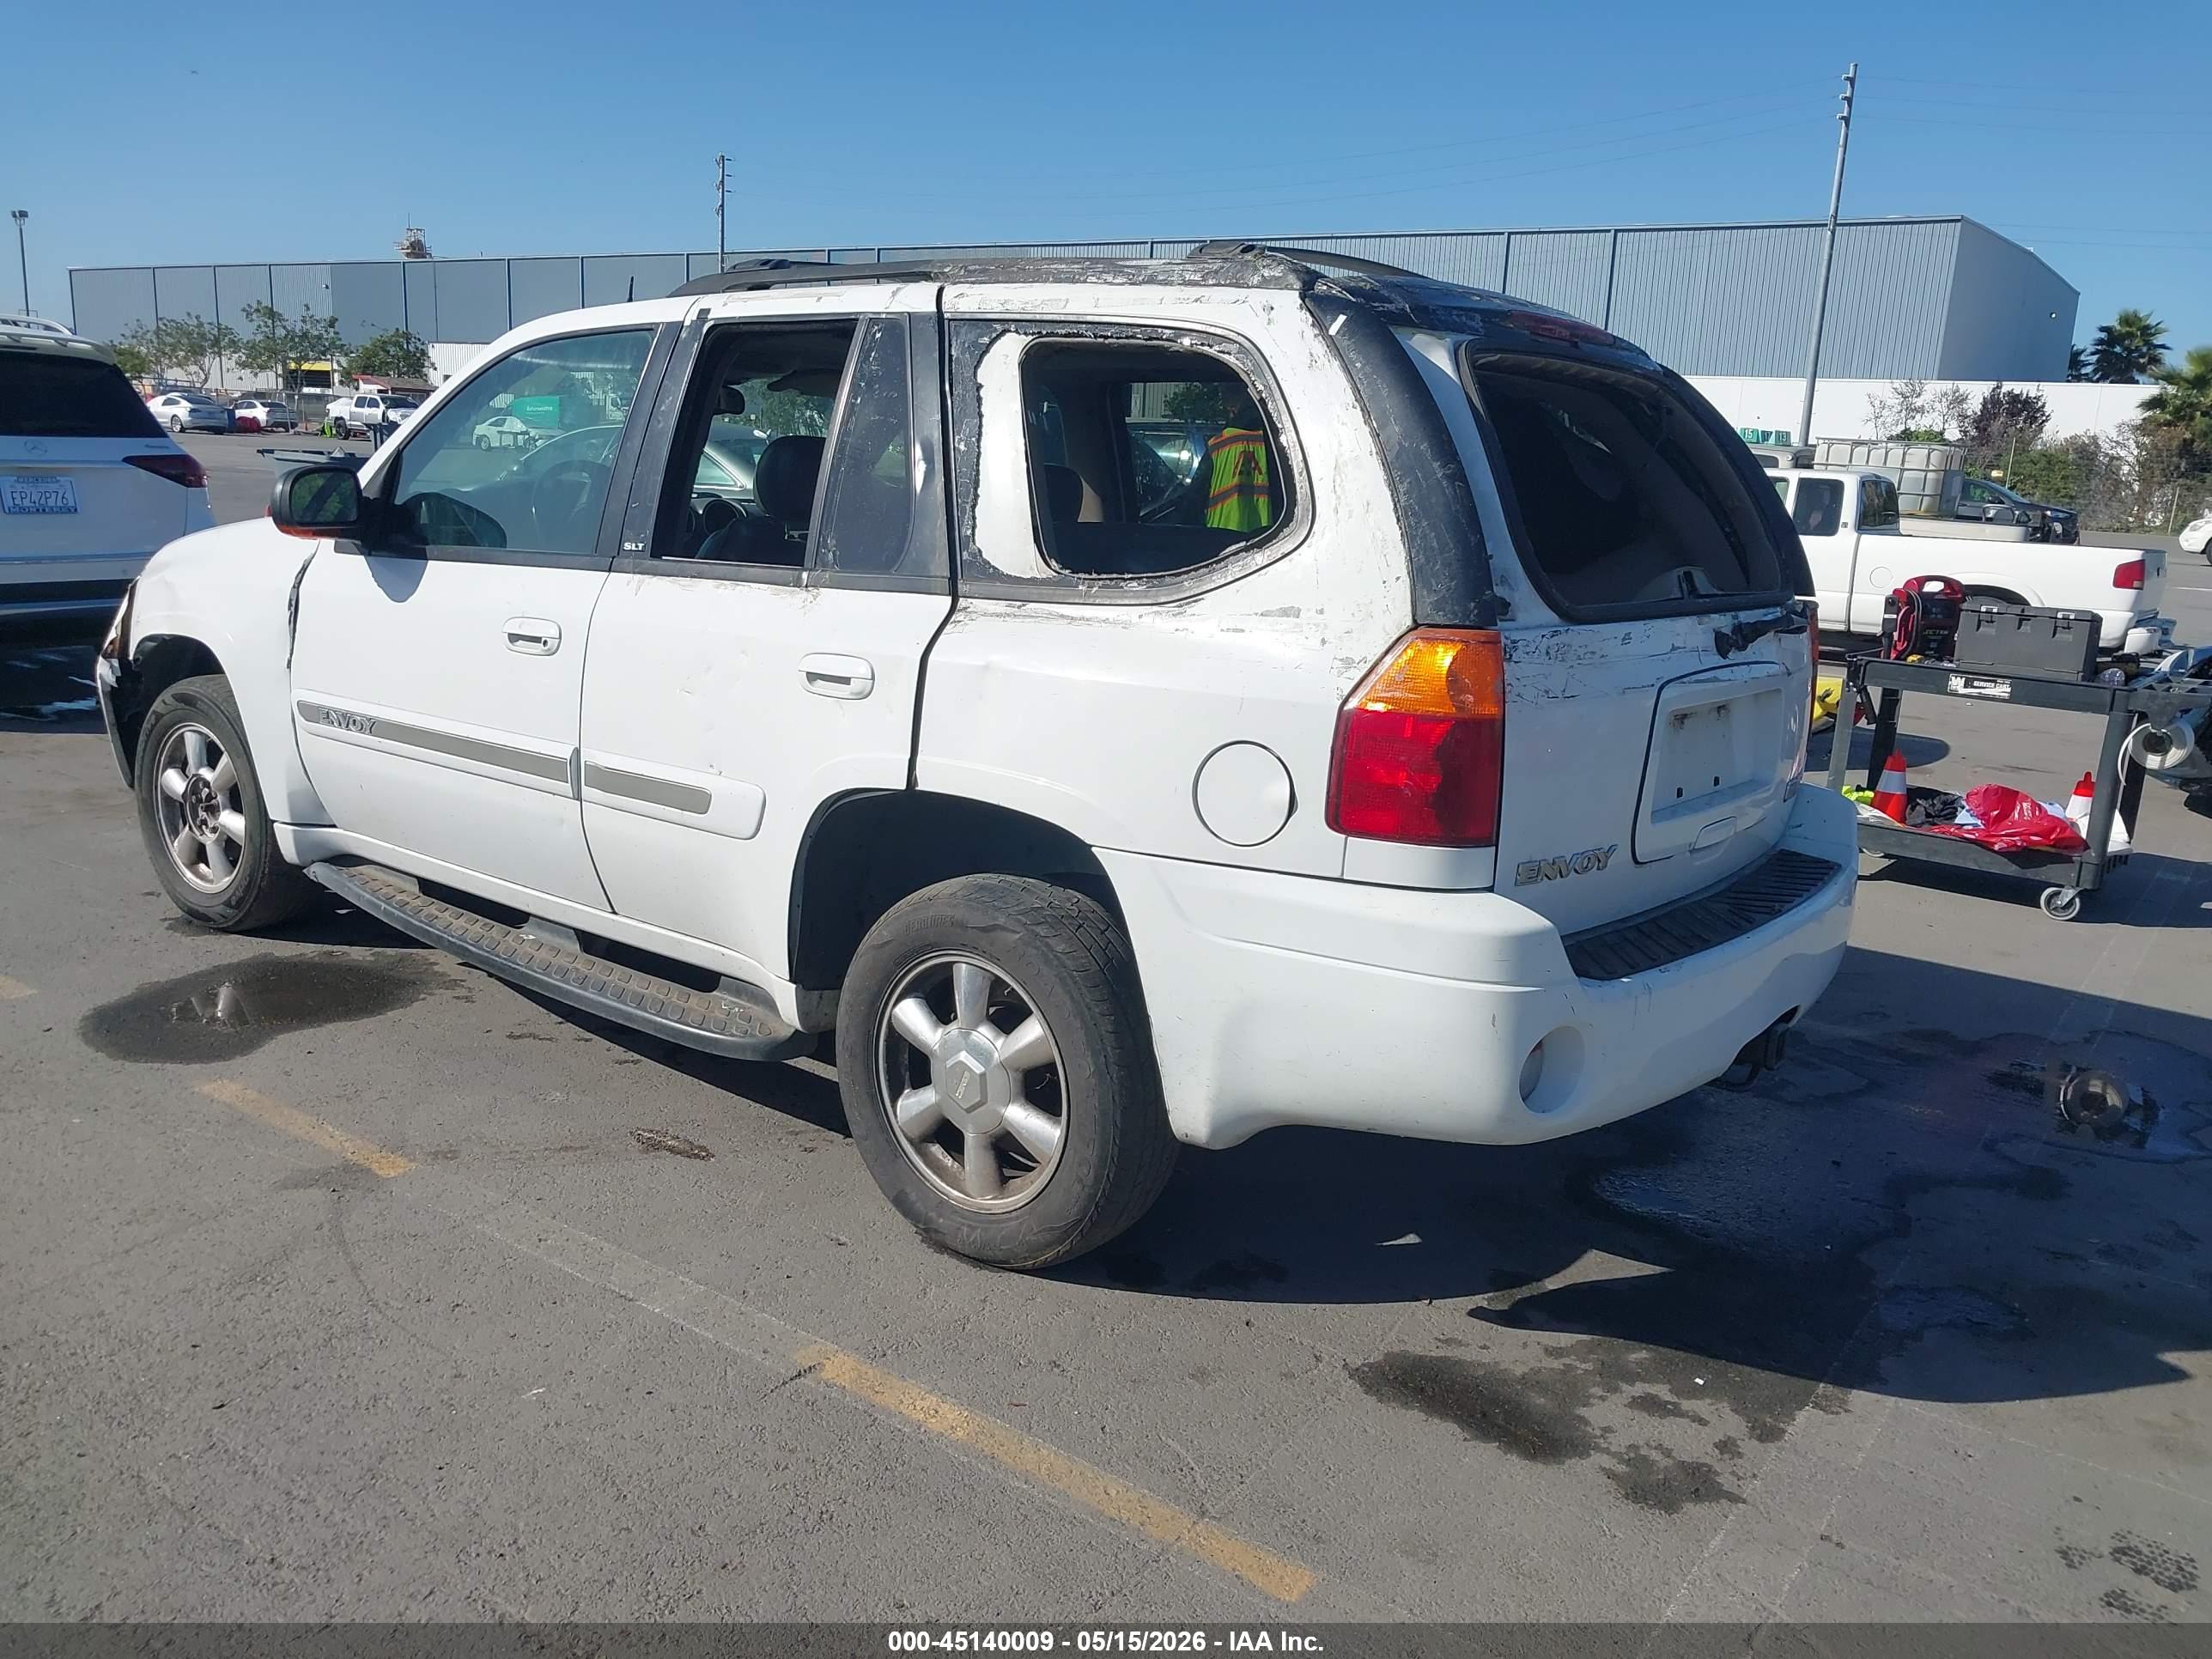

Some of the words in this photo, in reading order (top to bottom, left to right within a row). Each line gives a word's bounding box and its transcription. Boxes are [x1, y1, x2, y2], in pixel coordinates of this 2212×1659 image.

[1744, 428, 1753, 440] 15
[1778, 432, 1787, 441] 13
[10, 490, 69, 506] EP42P76
[623, 542, 645, 550] SLT
[1973, 680, 1995, 689] SERVICE
[318, 707, 378, 736] ENVOY
[1514, 844, 1618, 887] ENVOY
